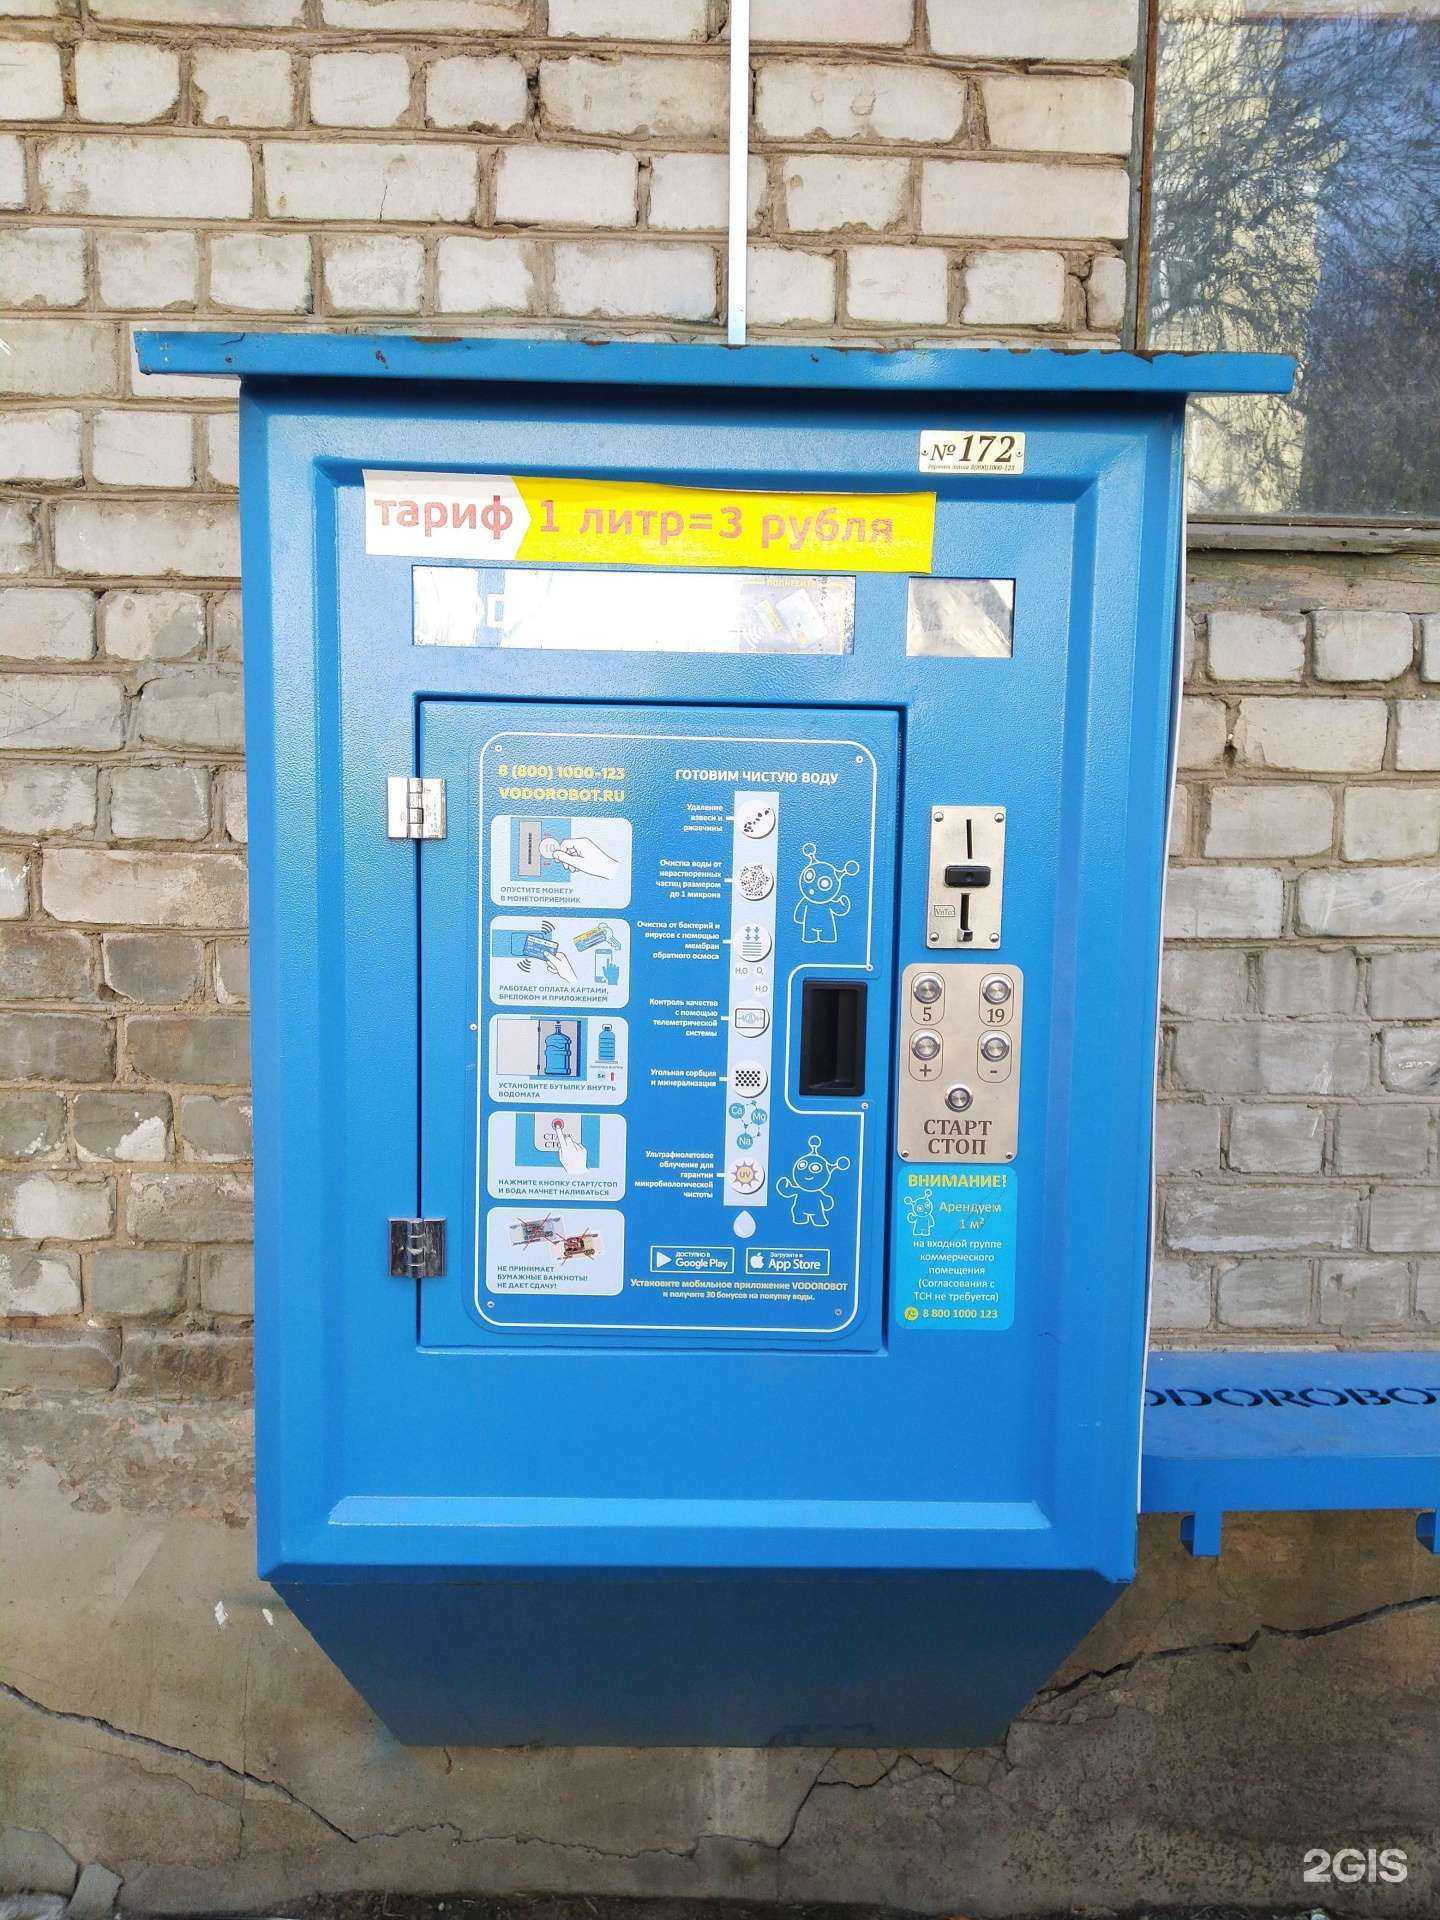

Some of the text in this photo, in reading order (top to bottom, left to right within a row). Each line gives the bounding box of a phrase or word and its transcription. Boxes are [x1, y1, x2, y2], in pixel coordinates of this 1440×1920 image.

[374, 495, 514, 539] тариф
[540, 500, 560, 532] 1
[760, 507, 894, 550] рубля
[675, 769, 838, 786] ГОТОВИМ ЧИСТУЮ ВОДУ
[686, 803, 724, 813] Удаление
[683, 825, 723, 833] ржавчины
[660, 859, 690, 868] Очистка
[691, 861, 712, 869] воды
[659, 870, 722, 879] нерастворенных
[500, 886, 574, 895] ОПУСТИТЕ МОНЕТУ
[682, 882, 721, 890] размером
[500, 895, 581, 904] В МОНЕТОПРИЕМНИК
[669, 890, 721, 900] до 1 микрона
[636, 920, 668, 929] Очистка
[678, 921, 713, 931] бактерий
[645, 932, 676, 941] вирусов
[681, 933, 720, 941] помощью
[684, 942, 720, 950] мембран
[652, 951, 691, 961] обратного
[499, 984, 609, 996] РАБОТАЕТ ОПЛАТА КАРТАМИ,
[499, 993, 543, 1001] БРЕЛОКОМ
[548, 994, 608, 1003] ПРИЛОЖЕНИЕМ
[649, 998, 685, 1007] Контроль
[680, 1010, 718, 1018] помощью
[922, 1006, 932, 1022] 5
[986, 1007, 1005, 1023] 19
[653, 1019, 718, 1028] телеметрической
[650, 1068, 717, 1078] Угольная сорбция
[498, 1082, 617, 1092] УСТАНОВИТЕ БУТЫЛКУ ВНУТРЬ
[657, 1080, 717, 1088] минерализация
[498, 1091, 540, 1099] ВОДОМАТА
[731, 1106, 743, 1114] Ca
[923, 1118, 993, 1136] СТАРТ
[739, 1137, 751, 1145] Na
[927, 1138, 988, 1155] СТОП
[645, 1150, 714, 1160] Ультрафиолетовое
[659, 1161, 714, 1170] облучение для
[680, 1171, 714, 1180] гарантии
[739, 1171, 751, 1179] UV
[498, 1178, 618, 1189] НАЖМИТЕ КНОПКУ СТАРТ/СТОП
[634, 1180, 714, 1189] микробиологической
[908, 1173, 1008, 1188] ВНИМАНИЕ!
[505, 1187, 527, 1195] ВОДА
[559, 1188, 609, 1196] НАЛИВАТЬСЯ
[683, 1190, 713, 1199] чистоты
[938, 1200, 1002, 1215] Арендуем
[959, 1218, 966, 1229] 1
[927, 1239, 967, 1250] входной
[969, 1240, 1003, 1251] группе
[769, 1251, 799, 1260] Загрузите
[920, 1252, 995, 1263] коммерческого
[675, 1257, 728, 1270] Google Play
[768, 1259, 821, 1271] App Store
[497, 1265, 555, 1273] НЕ ПРИНИМАЕТ
[928, 1266, 986, 1275] помещения
[497, 1273, 542, 1281] БУМАЖНЫЕ
[508, 1282, 529, 1290] ДАЕТ
[630, 1278, 680, 1288] Установите
[681, 1279, 733, 1289] мобильное
[733, 1282, 790, 1291] приложение
[918, 1277, 987, 1289] (Согласования
[669, 1292, 704, 1300] получите
[716, 1291, 747, 1300] бонусов
[759, 1293, 791, 1301] покупку
[913, 1291, 932, 1300] ТСН
[949, 1292, 999, 1303] требуется)
[922, 1309, 998, 1318] 8 800 1000 123
